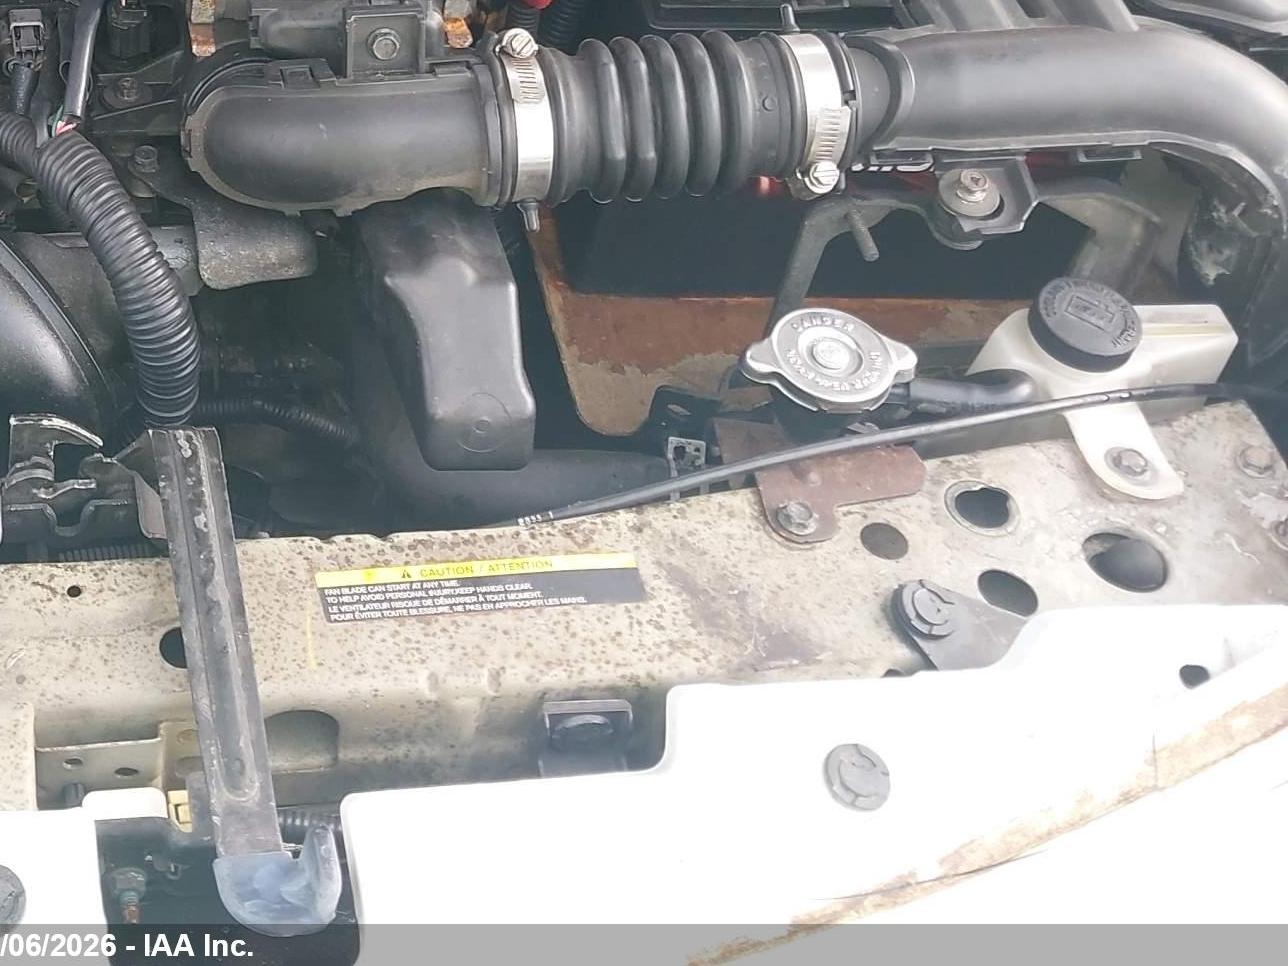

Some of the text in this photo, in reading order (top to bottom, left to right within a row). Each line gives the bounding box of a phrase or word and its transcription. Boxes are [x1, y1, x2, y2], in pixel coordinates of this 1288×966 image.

[420, 566, 473, 578] CAUTION
[488, 560, 553, 572] ATTENTION
[324, 588, 340, 596] FAN
[341, 586, 367, 595] BLADE
[368, 585, 386, 593] CAN
[387, 583, 411, 592] START
[326, 596, 339, 604] TO
[339, 595, 359, 603] HELP
[360, 593, 385, 602] AVOID
[386, 591, 428, 600] PERSONAL
[330, 613, 354, 621] POUR
[383, 609, 408, 618] TOUTE
